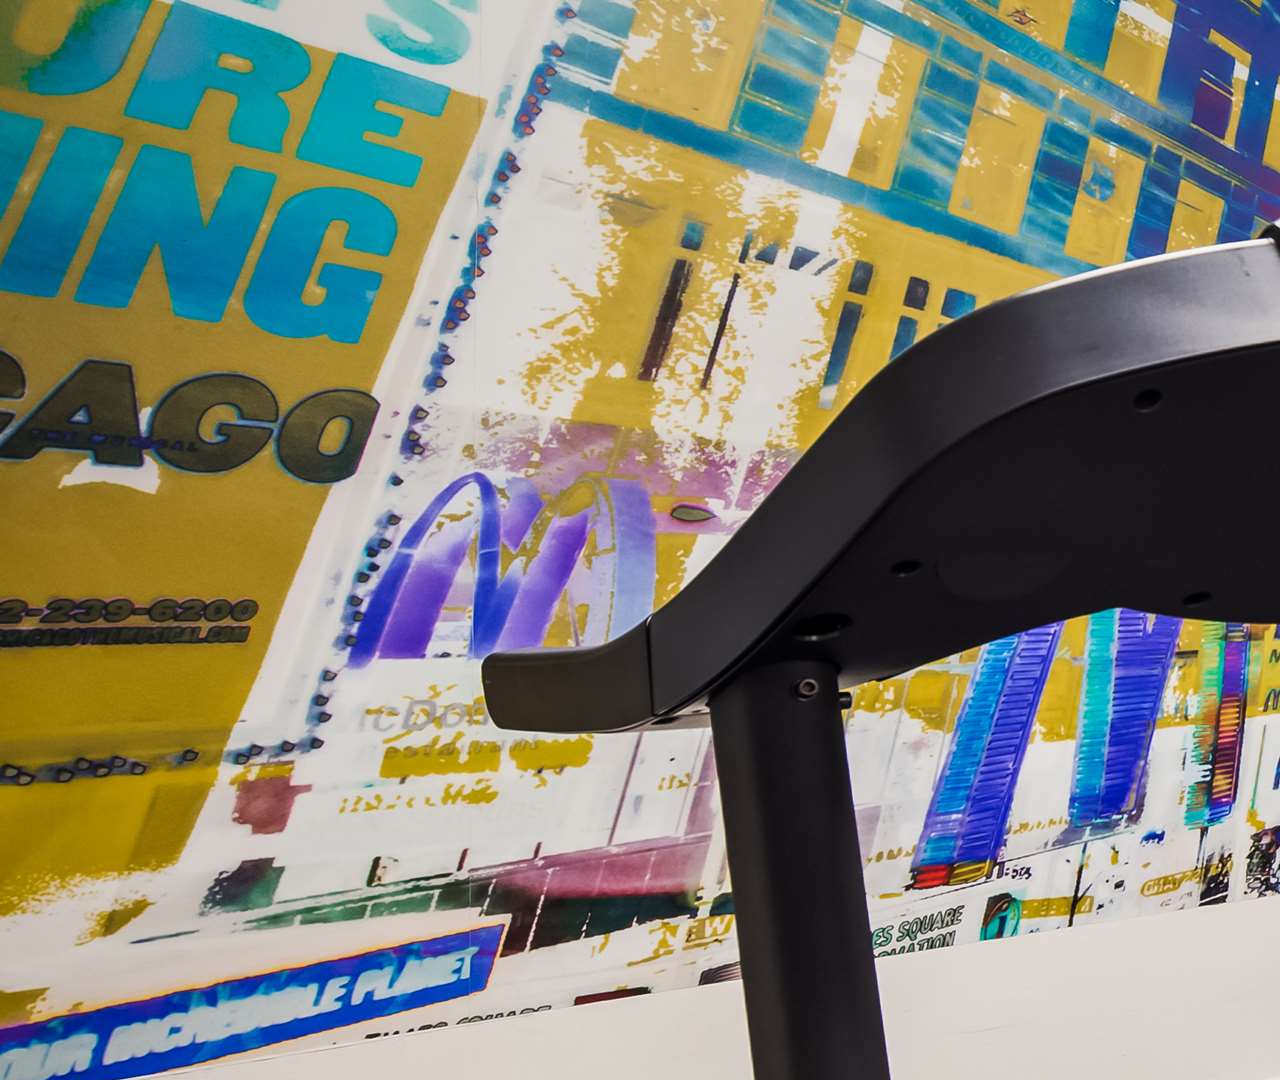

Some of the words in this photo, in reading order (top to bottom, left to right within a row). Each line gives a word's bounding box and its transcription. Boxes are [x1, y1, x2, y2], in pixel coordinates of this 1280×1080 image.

[0, 110, 398, 344] ING
[0, 349, 380, 485] AGO
[896, 904, 965, 943] SQUARE
[350, 946, 480, 1006] PLANET
